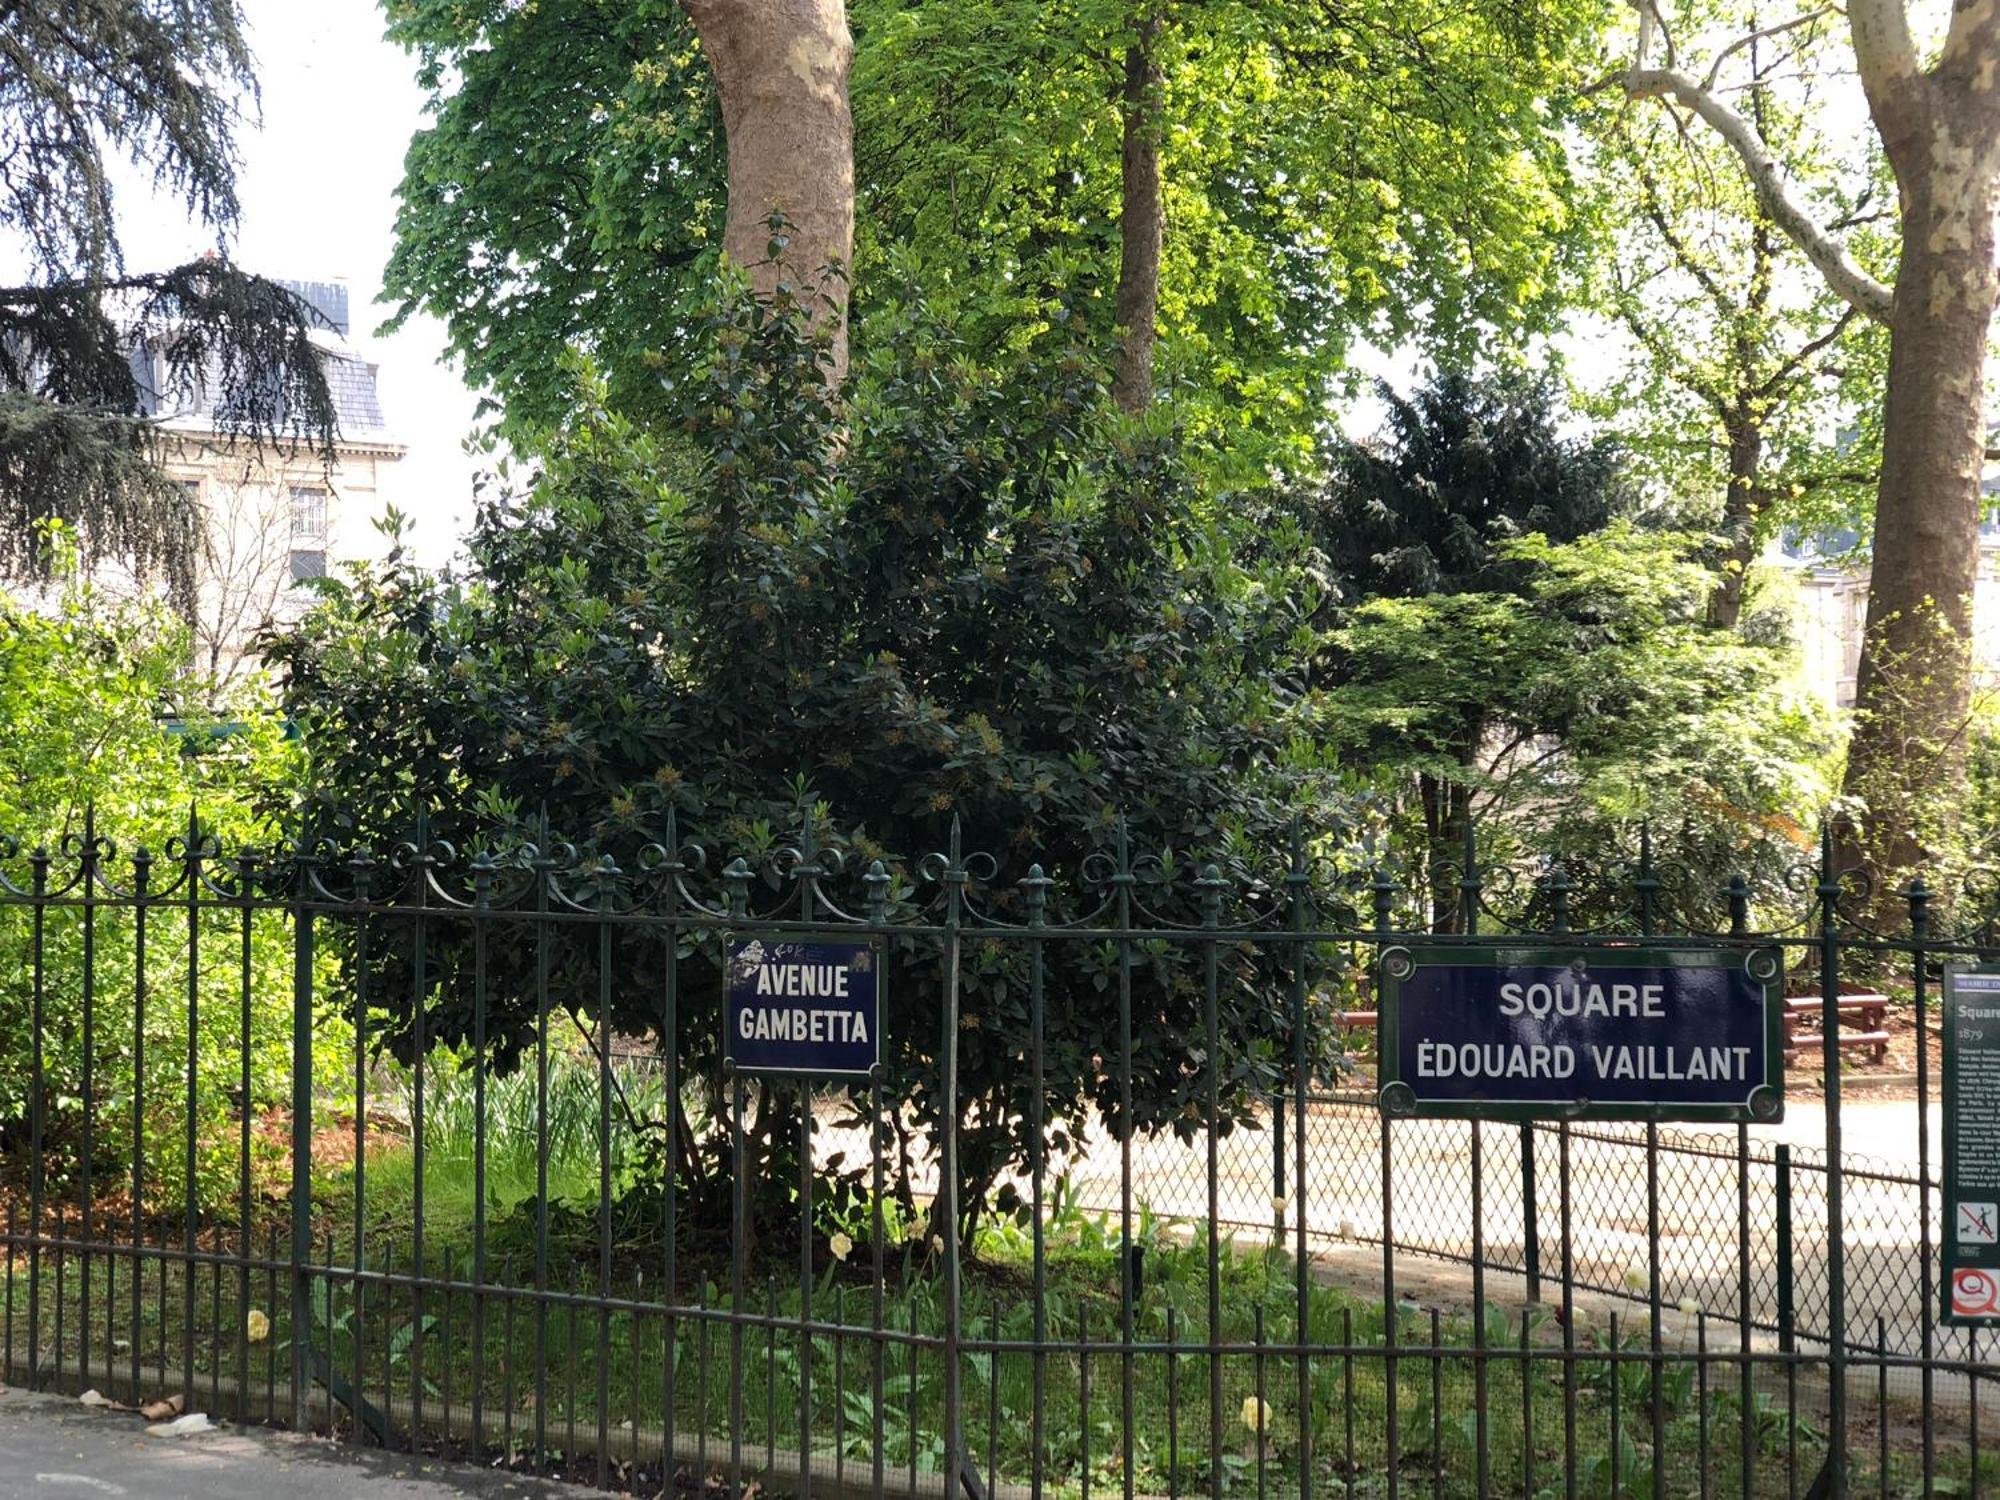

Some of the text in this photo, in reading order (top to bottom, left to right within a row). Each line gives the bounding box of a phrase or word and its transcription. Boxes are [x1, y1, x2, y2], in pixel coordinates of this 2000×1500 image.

[756, 963, 849, 997] AVENUE
[1500, 983, 1665, 1020] SQUARE
[739, 1007, 868, 1043] GAMBETTA
[1417, 1038, 1751, 1081] ÉDOUARD VAILLANT
